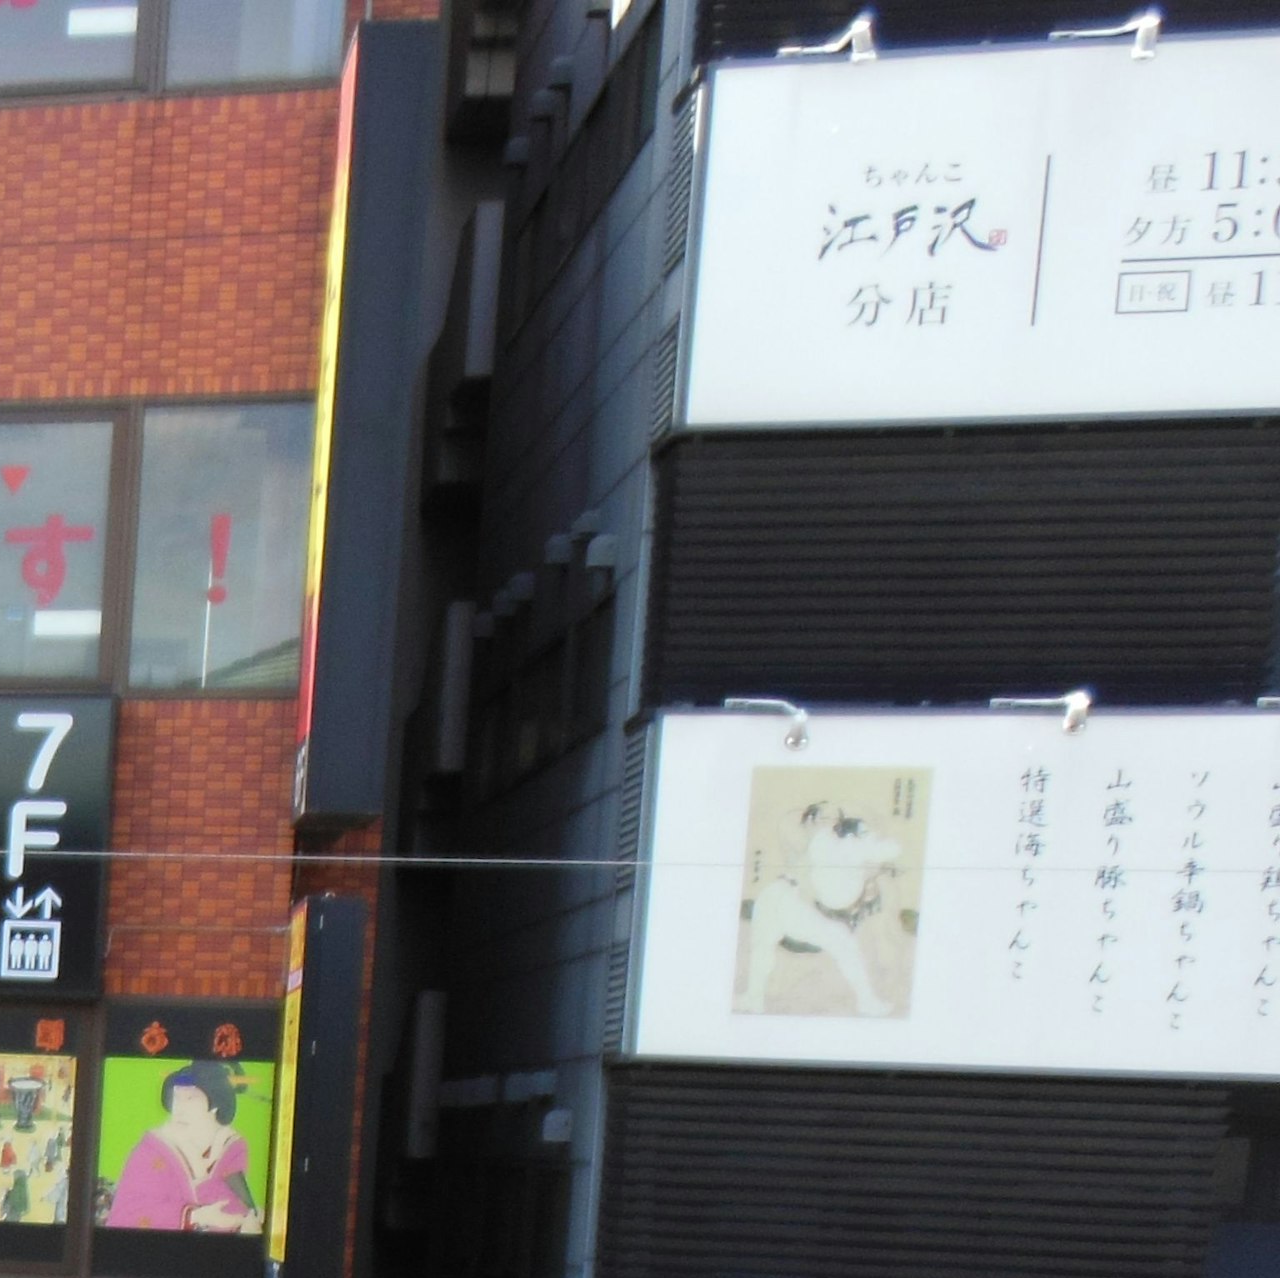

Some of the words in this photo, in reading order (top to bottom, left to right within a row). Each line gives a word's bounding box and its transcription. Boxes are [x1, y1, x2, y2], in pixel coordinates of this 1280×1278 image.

[862, 160, 965, 188] ちゃんこ
[1200, 149, 1280, 192] 11:
[818, 196, 1000, 260] 江戸沢
[1124, 214, 1192, 247] 夕方
[846, 280, 955, 329] 分店
[1248, 269, 1280, 306] 1
